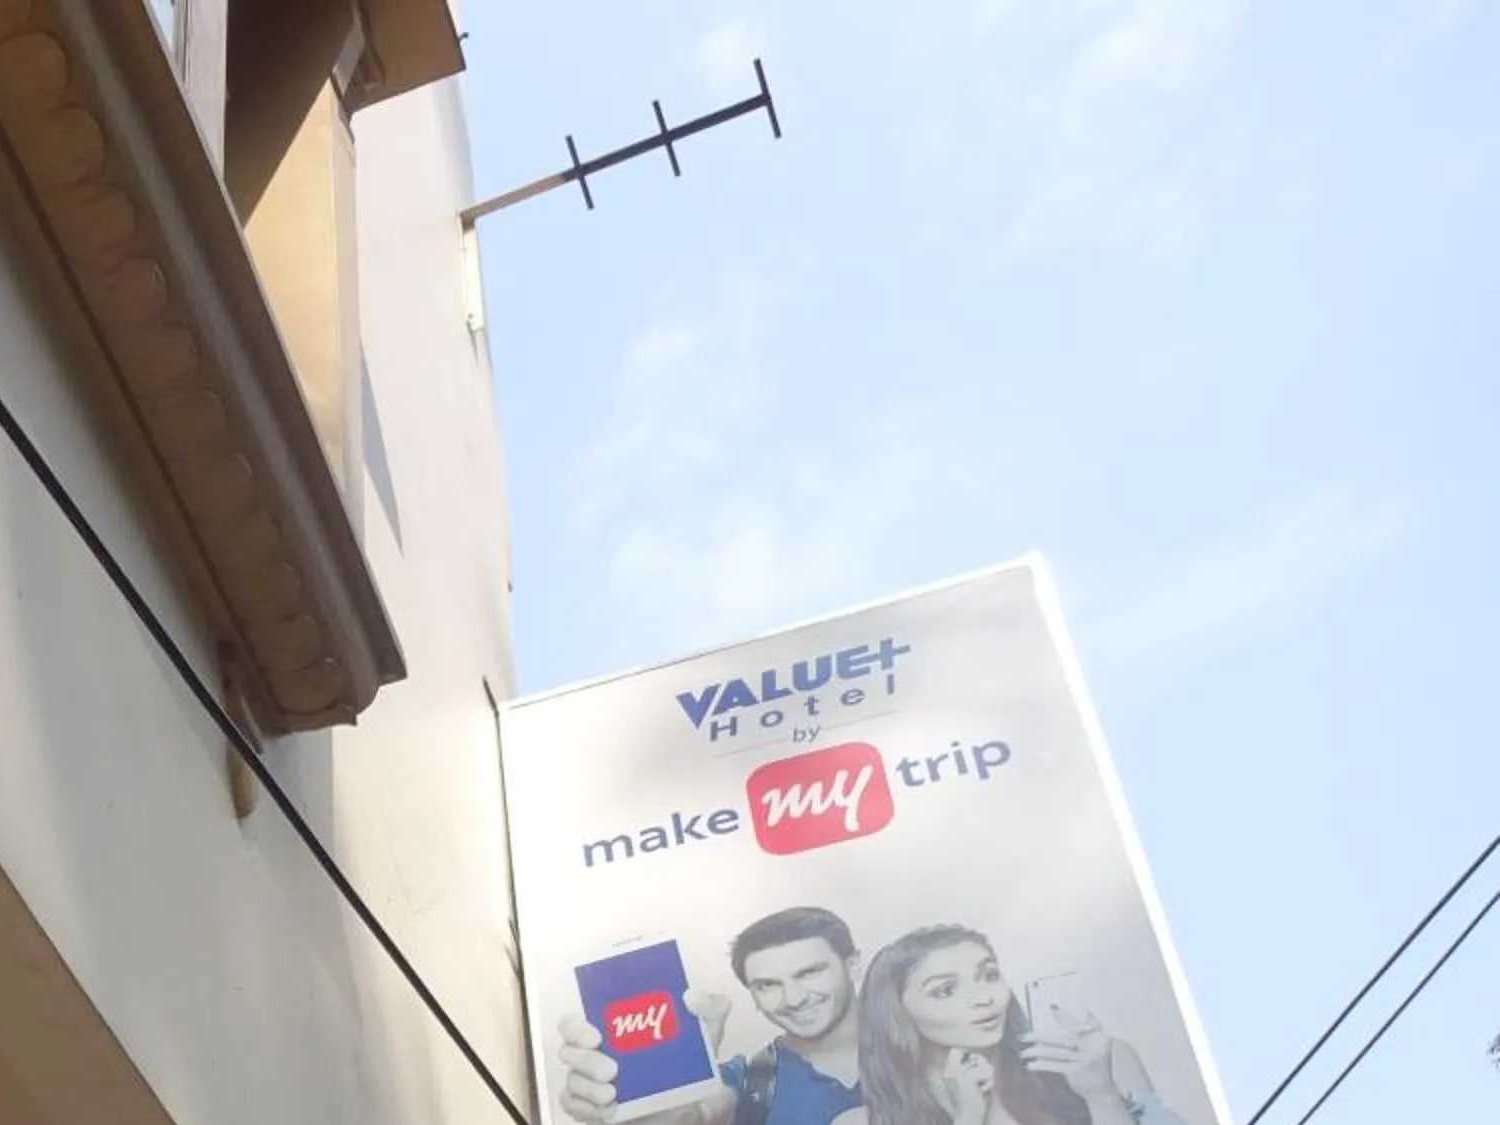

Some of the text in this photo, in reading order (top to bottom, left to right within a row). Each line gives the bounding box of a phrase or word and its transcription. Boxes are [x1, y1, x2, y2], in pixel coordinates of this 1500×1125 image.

[708, 673, 896, 742] Hotel
[792, 724, 821, 743] by
[582, 738, 1012, 867] make my trip
[612, 1003, 668, 1040] my
